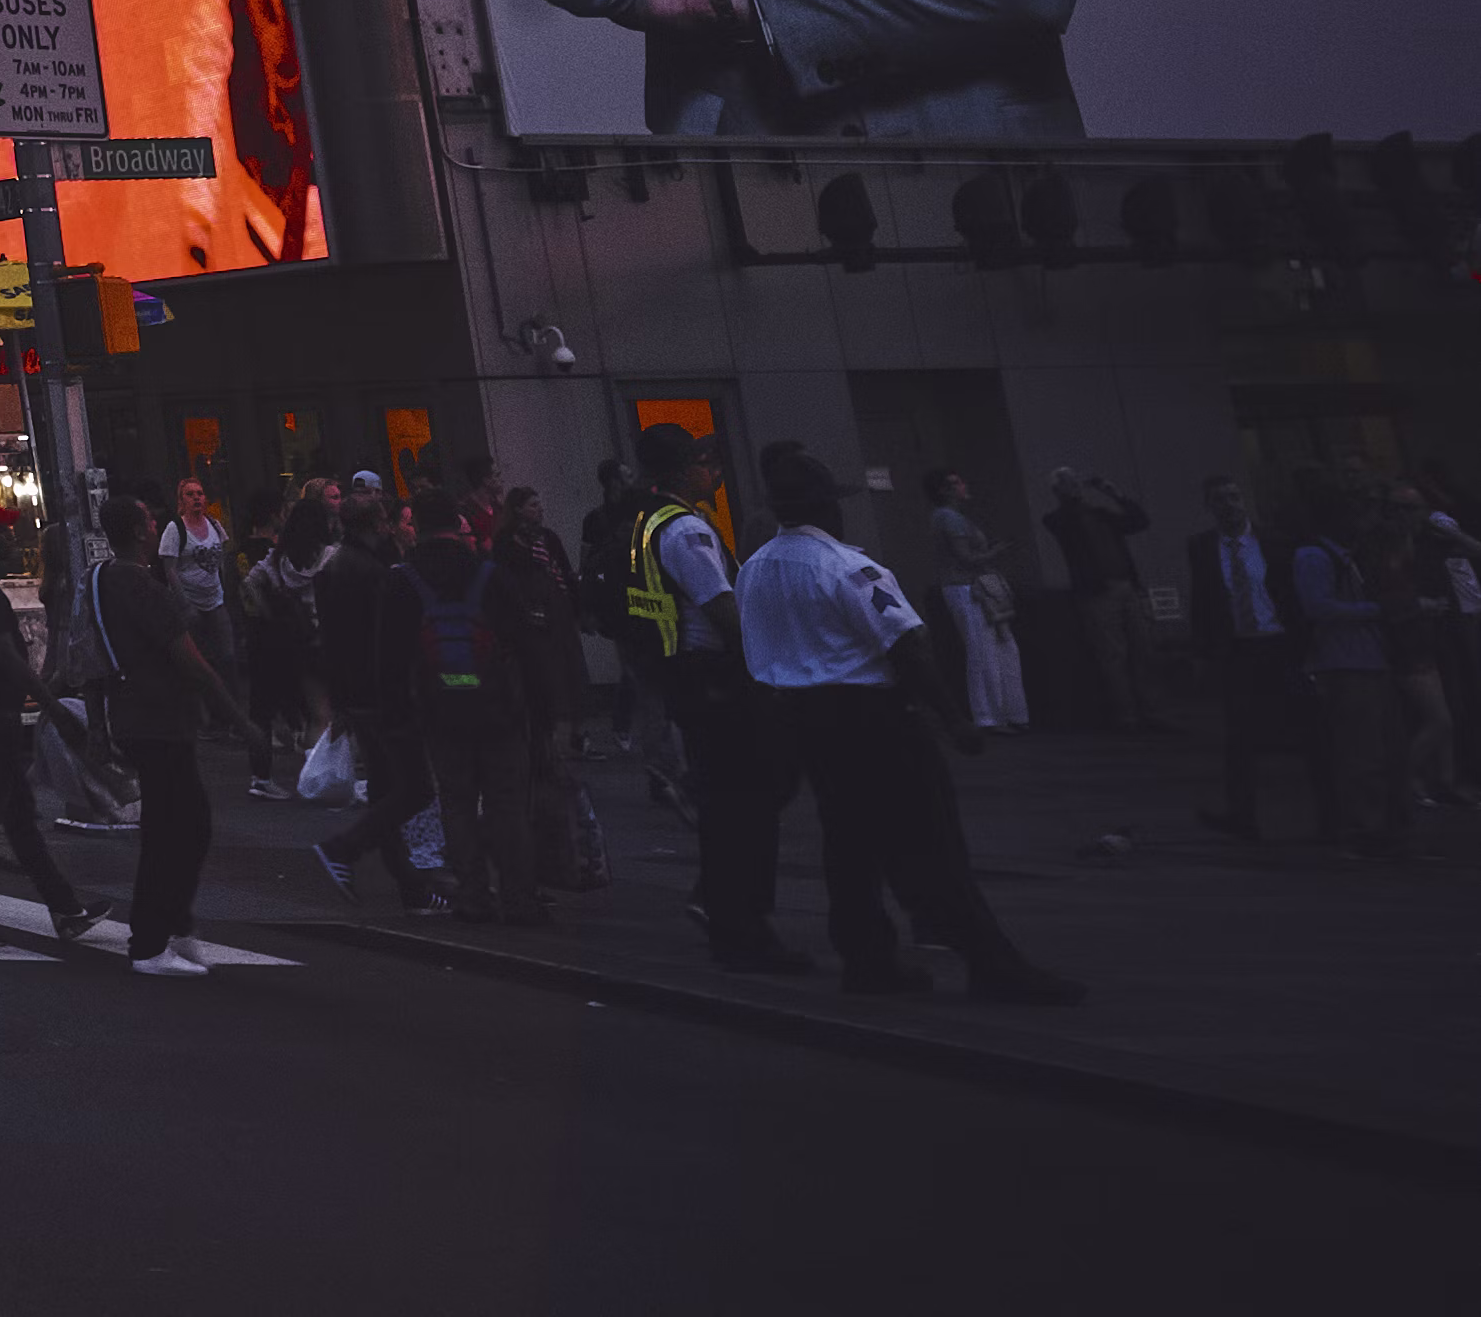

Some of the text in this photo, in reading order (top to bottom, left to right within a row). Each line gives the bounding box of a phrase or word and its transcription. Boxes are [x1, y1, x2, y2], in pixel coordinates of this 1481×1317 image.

[1, 24, 60, 50] ONLY
[12, 106, 98, 123] MON THRU FRI
[91, 144, 205, 175] Broadway
